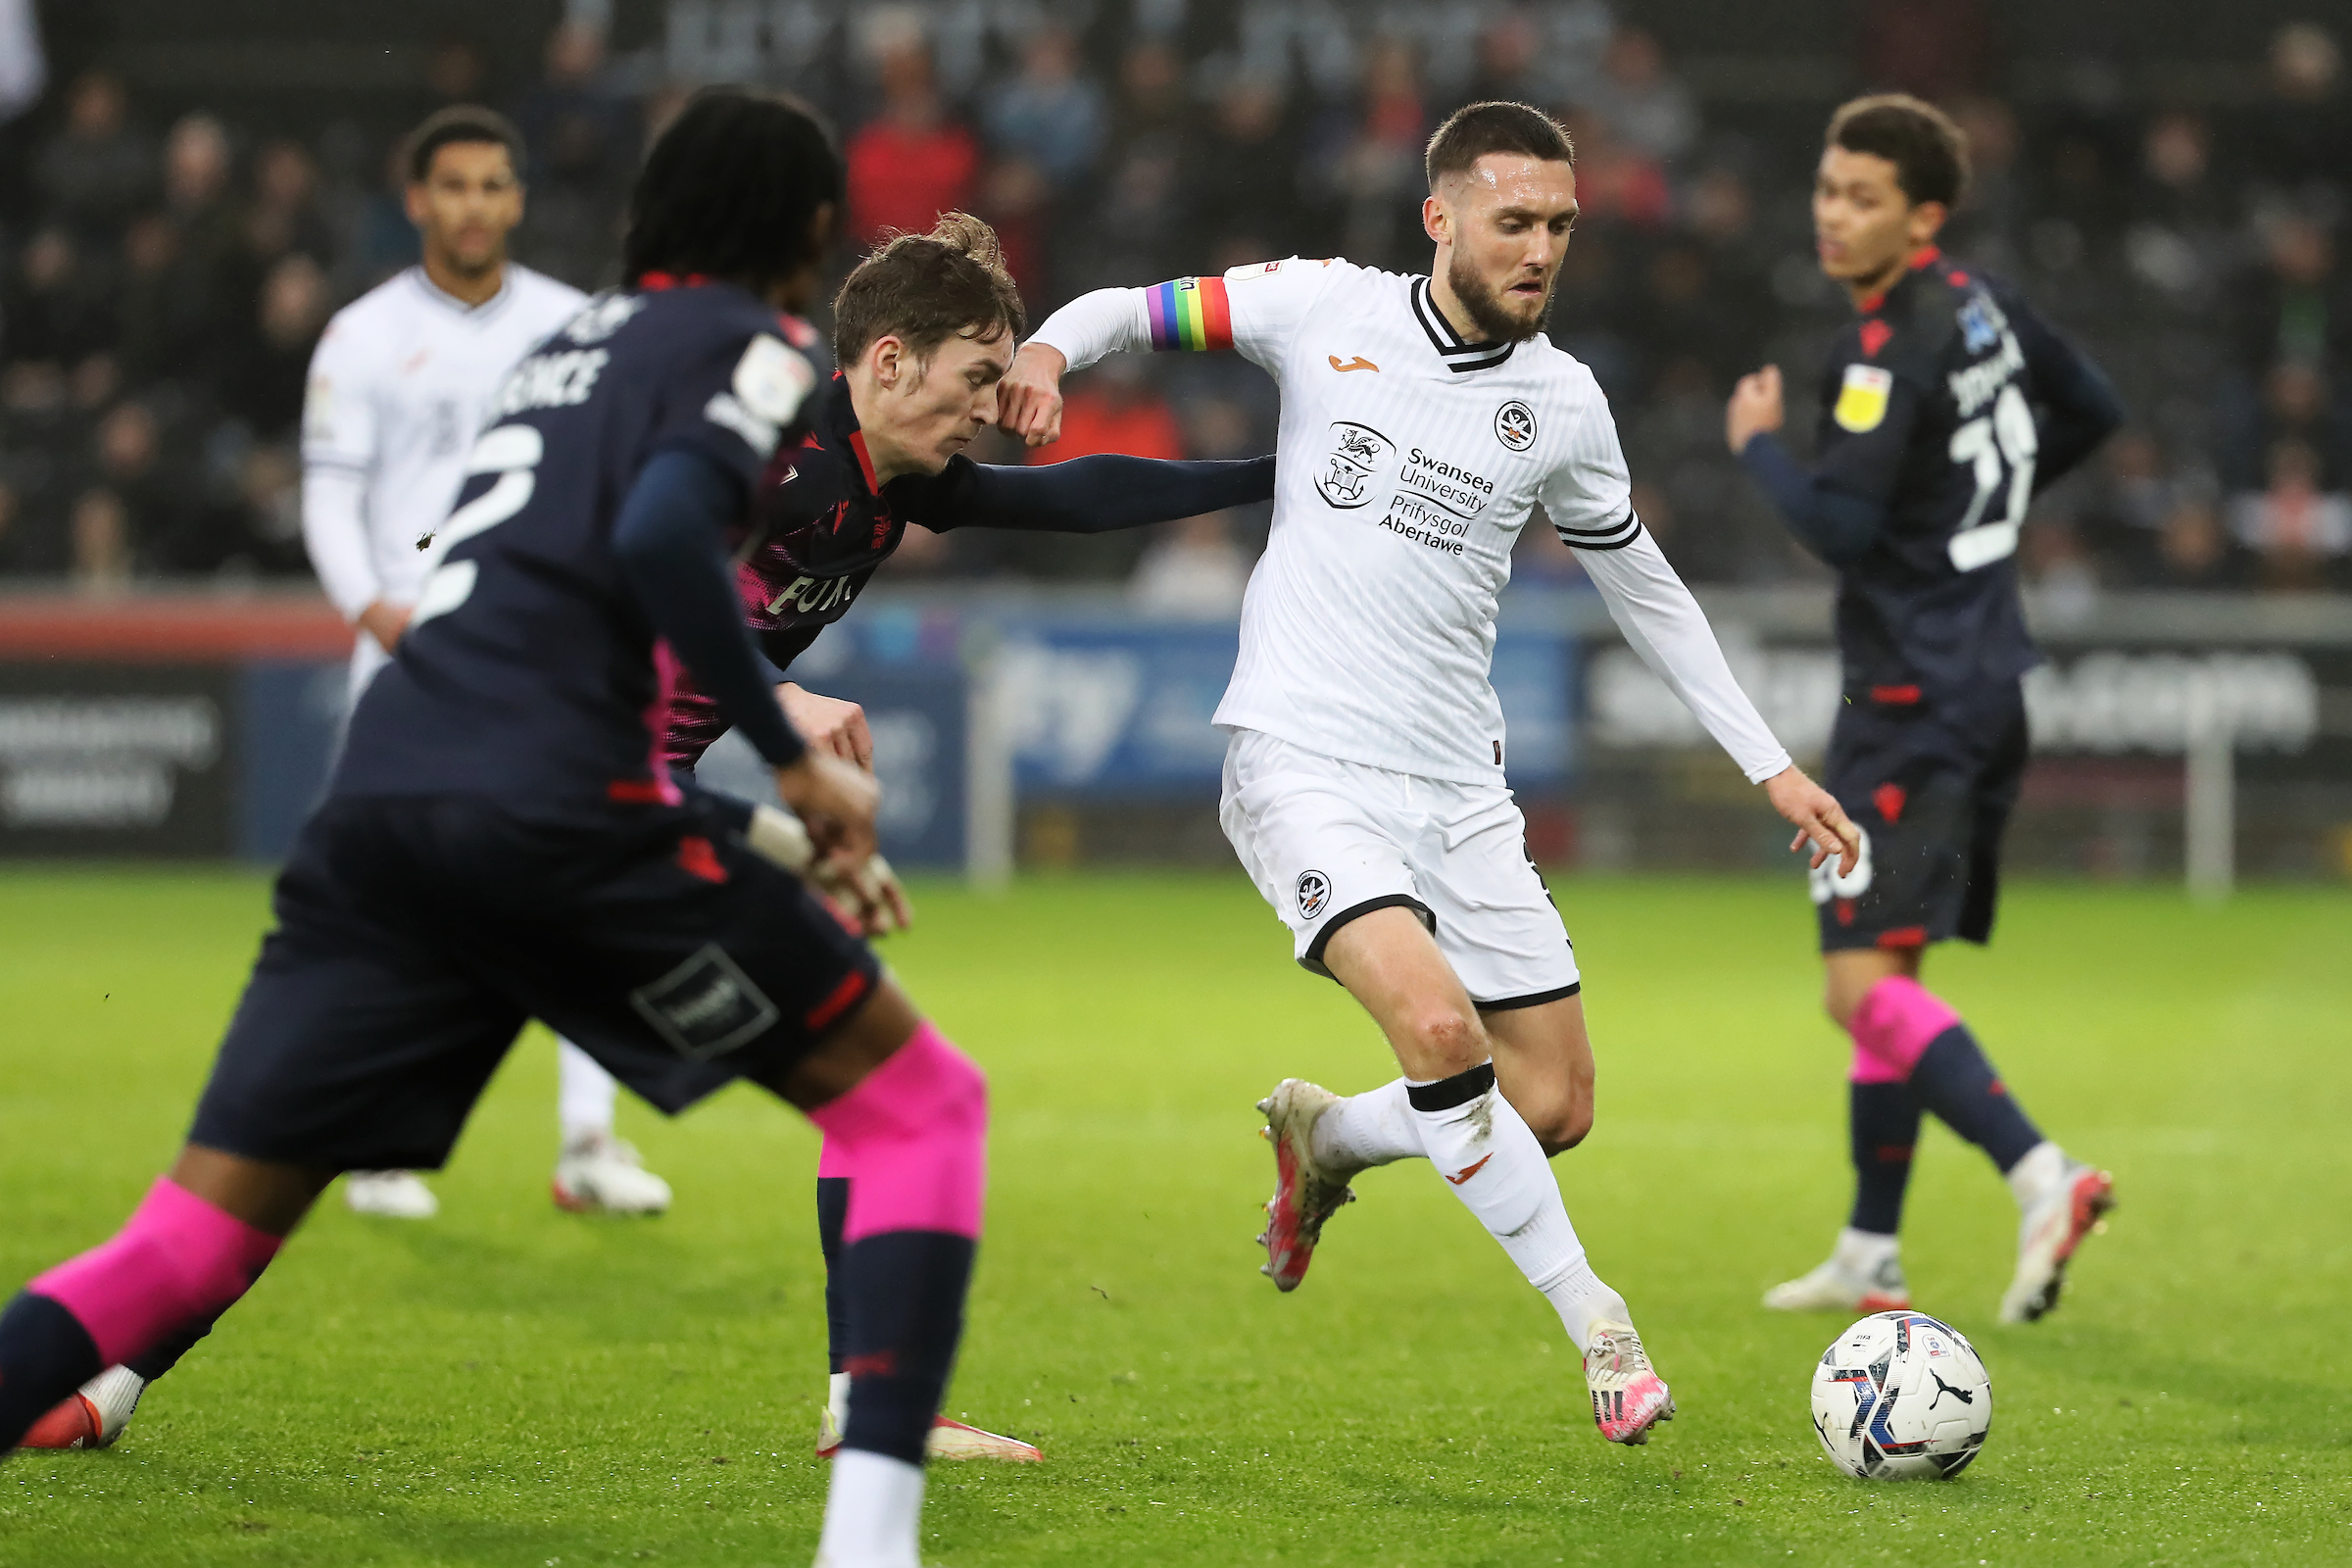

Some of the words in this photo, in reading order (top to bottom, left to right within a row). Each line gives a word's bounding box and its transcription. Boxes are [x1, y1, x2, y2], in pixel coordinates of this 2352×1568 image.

[1400, 465, 1487, 514] University
[1408, 448, 1494, 495] Swansea
[1379, 514, 1463, 556] Abertawe
[1390, 495, 1470, 538] Prifysgol
